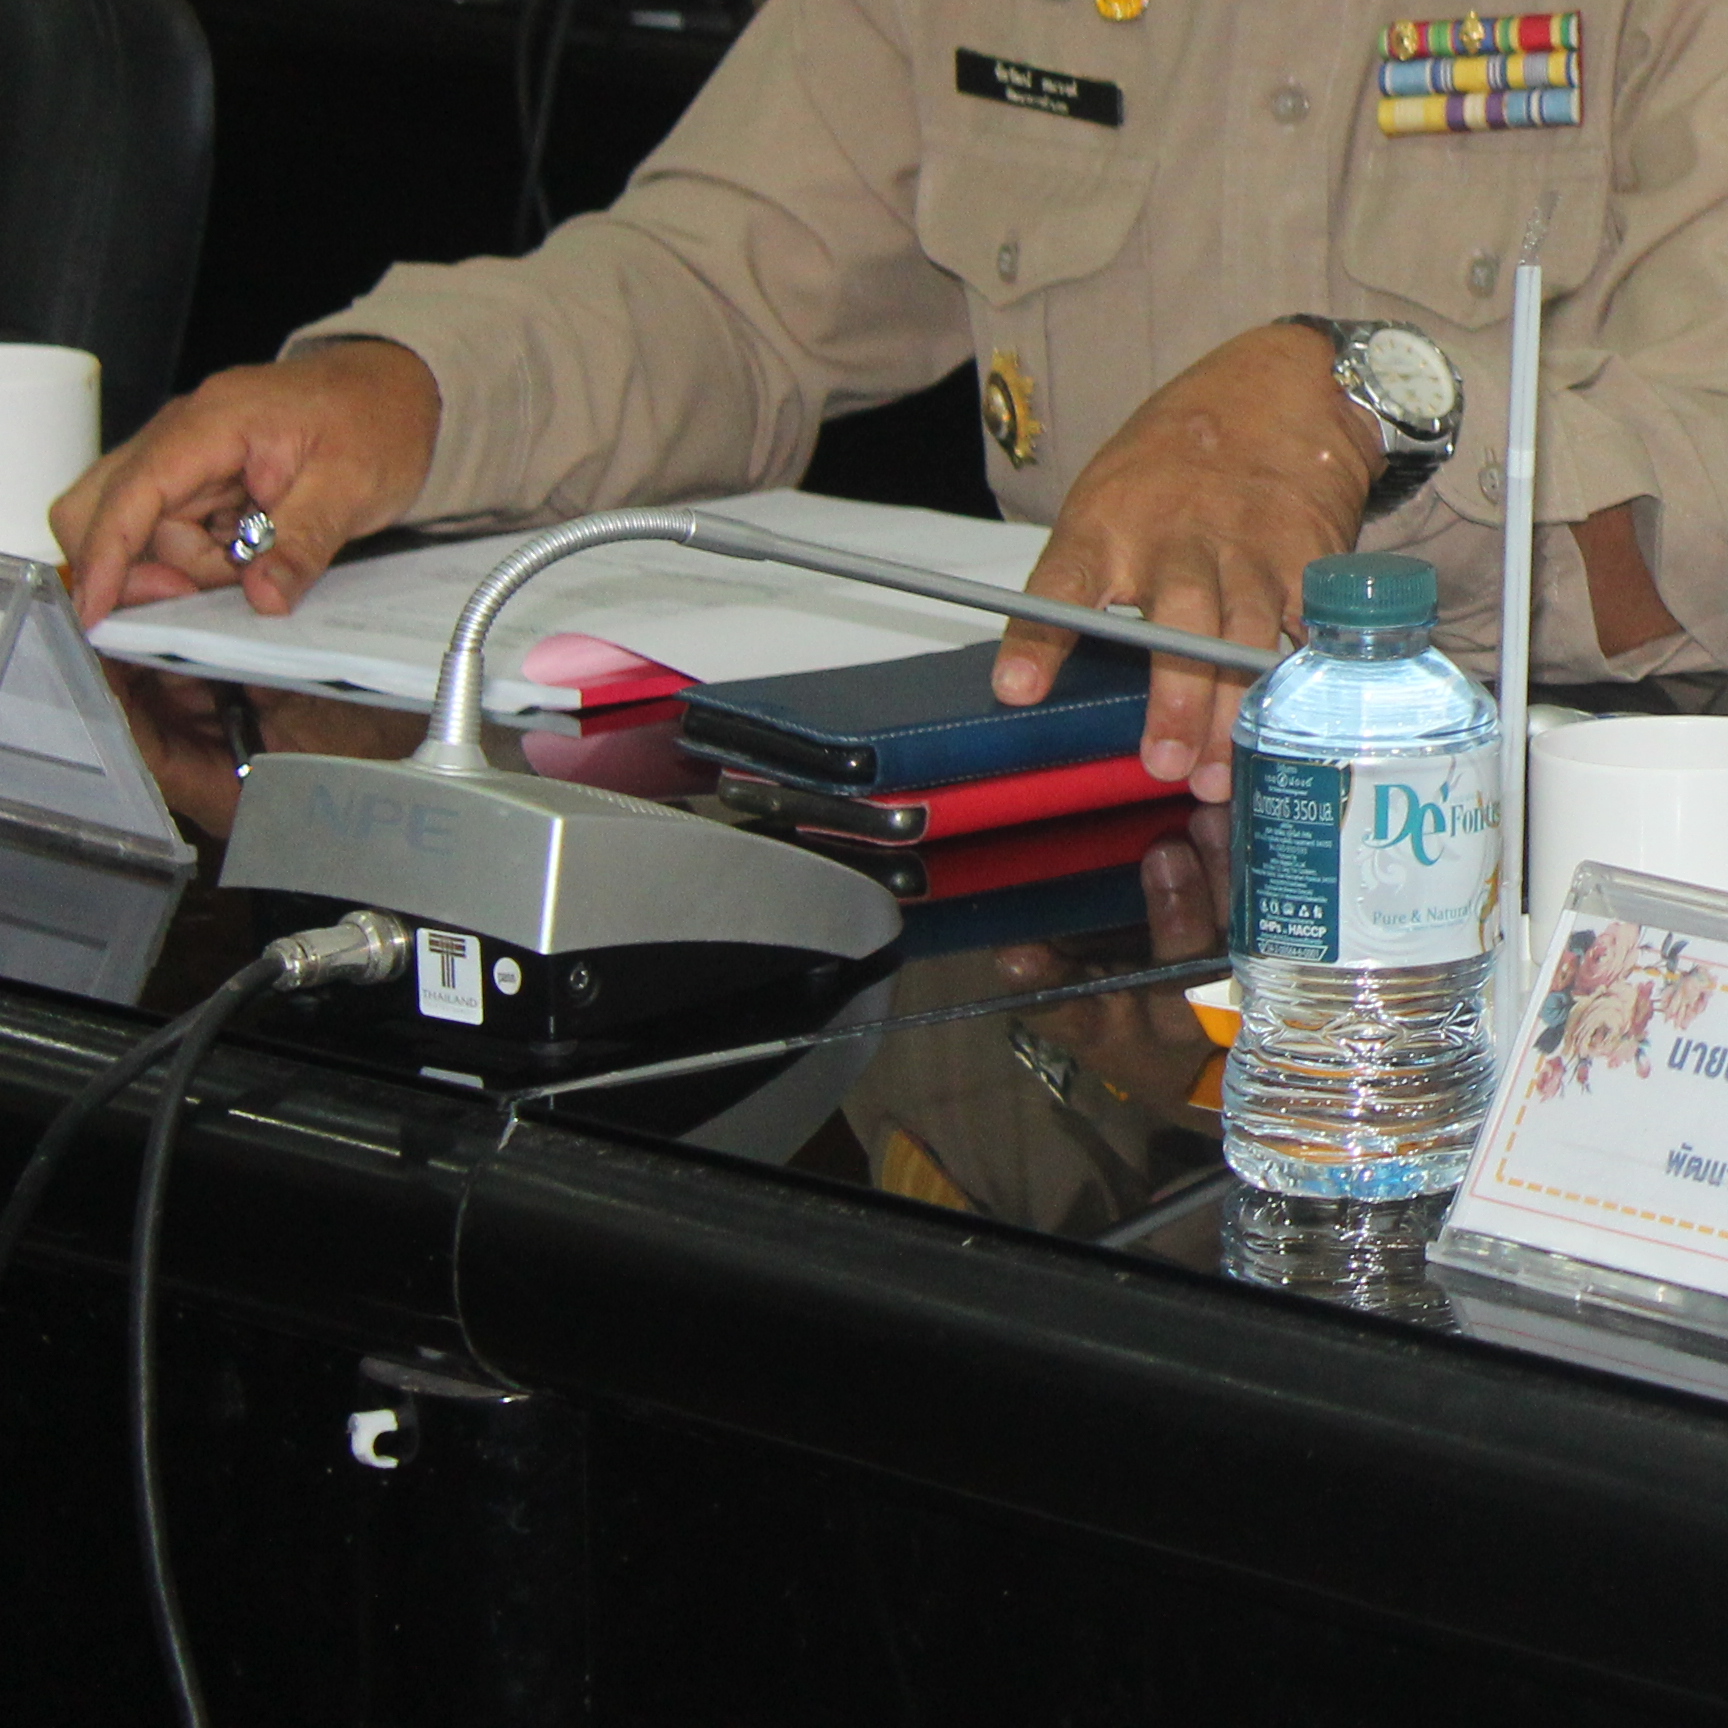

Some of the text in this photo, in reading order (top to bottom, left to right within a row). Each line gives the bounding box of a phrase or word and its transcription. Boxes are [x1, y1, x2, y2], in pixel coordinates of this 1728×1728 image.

[310, 783, 461, 855] NPE
[1293, 799, 1317, 821] 350
[1373, 899, 1472, 925] Pure & Natural
[1288, 924, 1328, 938] HACCP
[421, 988, 479, 1009] THAILAND
